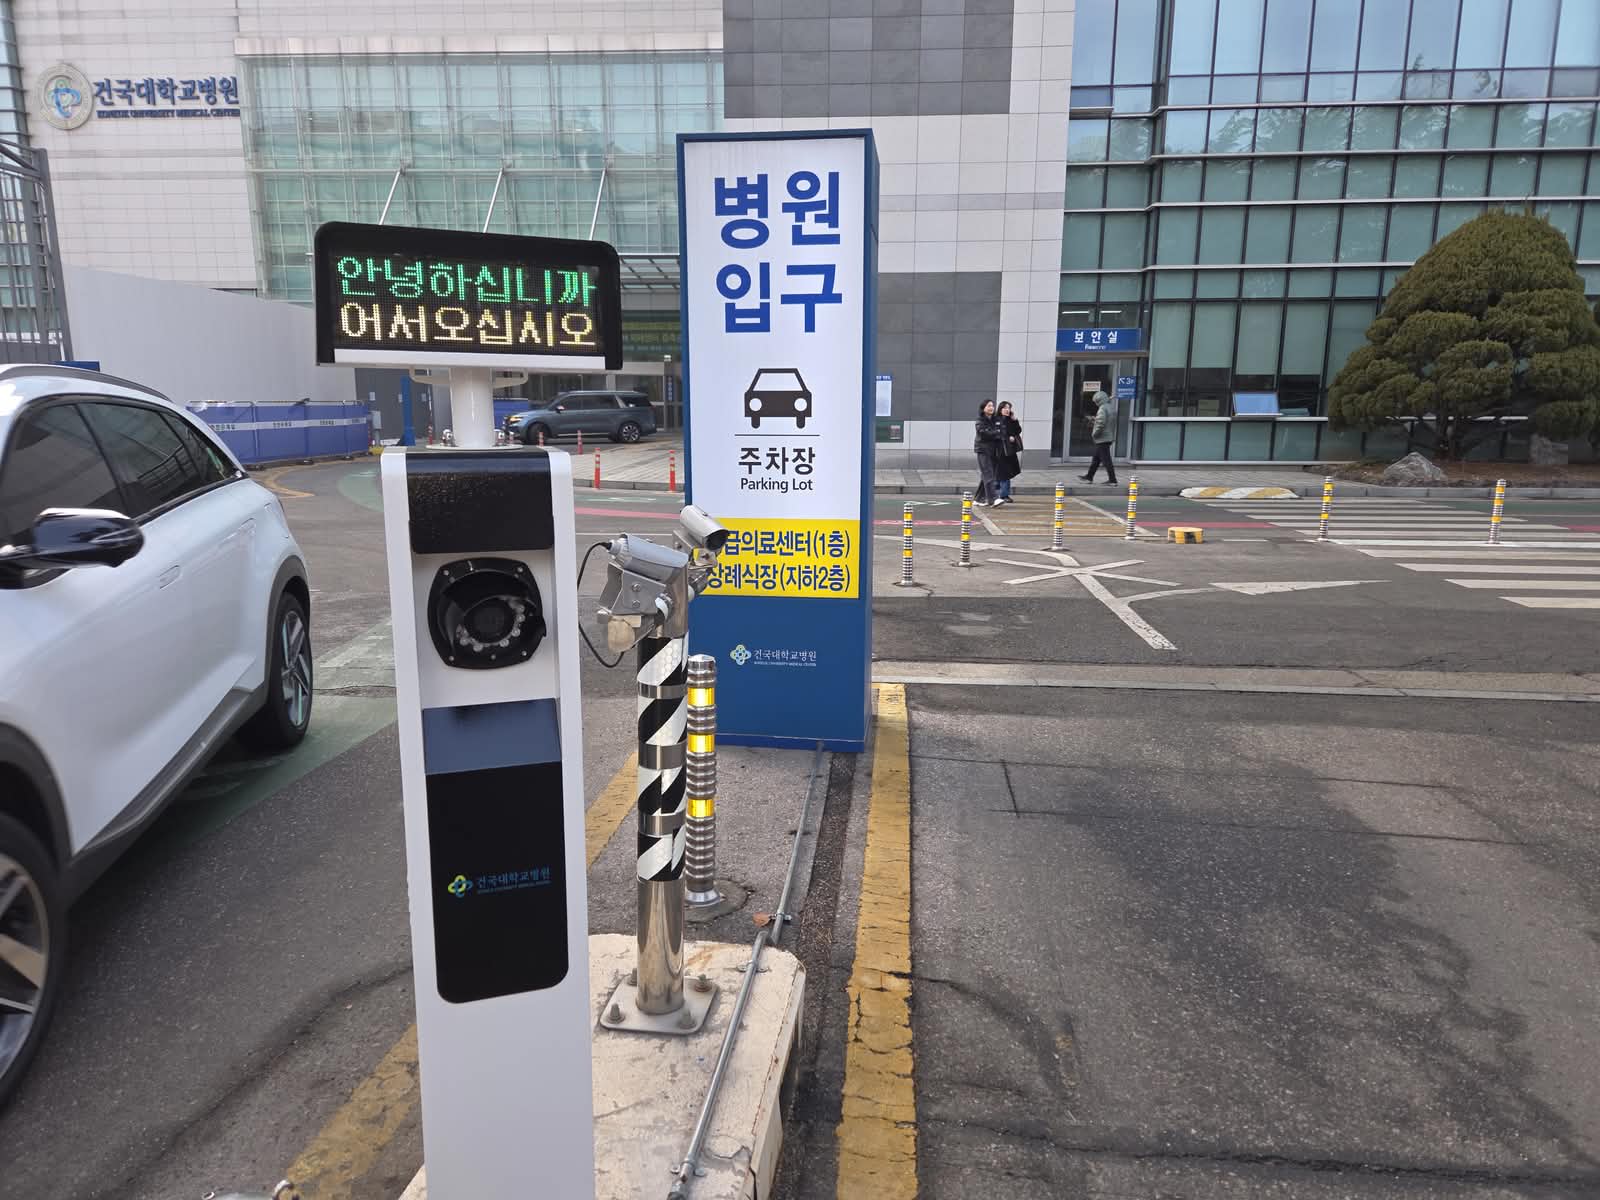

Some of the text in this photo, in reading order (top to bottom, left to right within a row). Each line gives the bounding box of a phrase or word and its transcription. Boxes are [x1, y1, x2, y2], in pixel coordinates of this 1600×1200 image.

[93, 76, 240, 106] 건국대학교병원
[714, 170, 841, 249] 병원
[337, 256, 597, 306] 안녕하십니까
[716, 262, 843, 333] 입구
[340, 302, 597, 347] 어서오십시오
[1073, 330, 1118, 344] 보안실
[738, 447, 816, 476] 주차장
[740, 478, 813, 493] Parking Lot
[724, 529, 851, 559] 급의료센터(1층)
